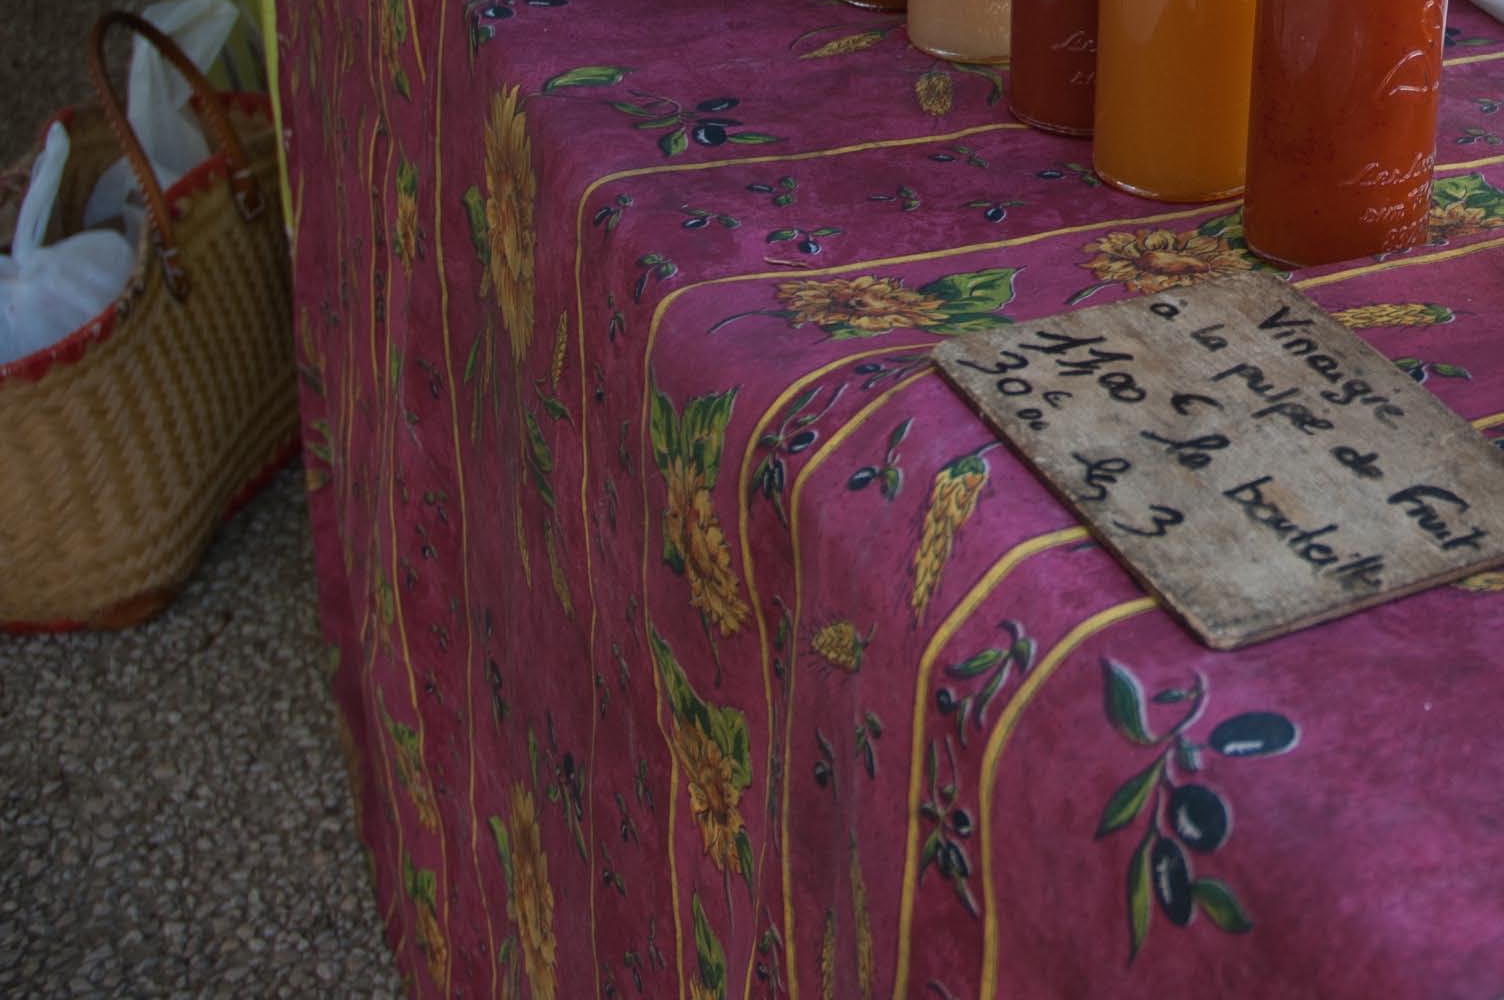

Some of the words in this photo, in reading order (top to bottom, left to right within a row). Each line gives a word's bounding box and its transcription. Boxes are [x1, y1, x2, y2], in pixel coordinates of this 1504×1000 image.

[1150, 299, 1186, 320] à
[1190, 323, 1229, 353] la
[1210, 361, 1335, 437] pulpe
[1331, 444, 1385, 482] de
[1388, 483, 1497, 552] Fruit
[1258, 305, 1406, 428] Vinaigre
[1112, 503, 1185, 540] 3
[1223, 475, 1387, 592] bouteille
